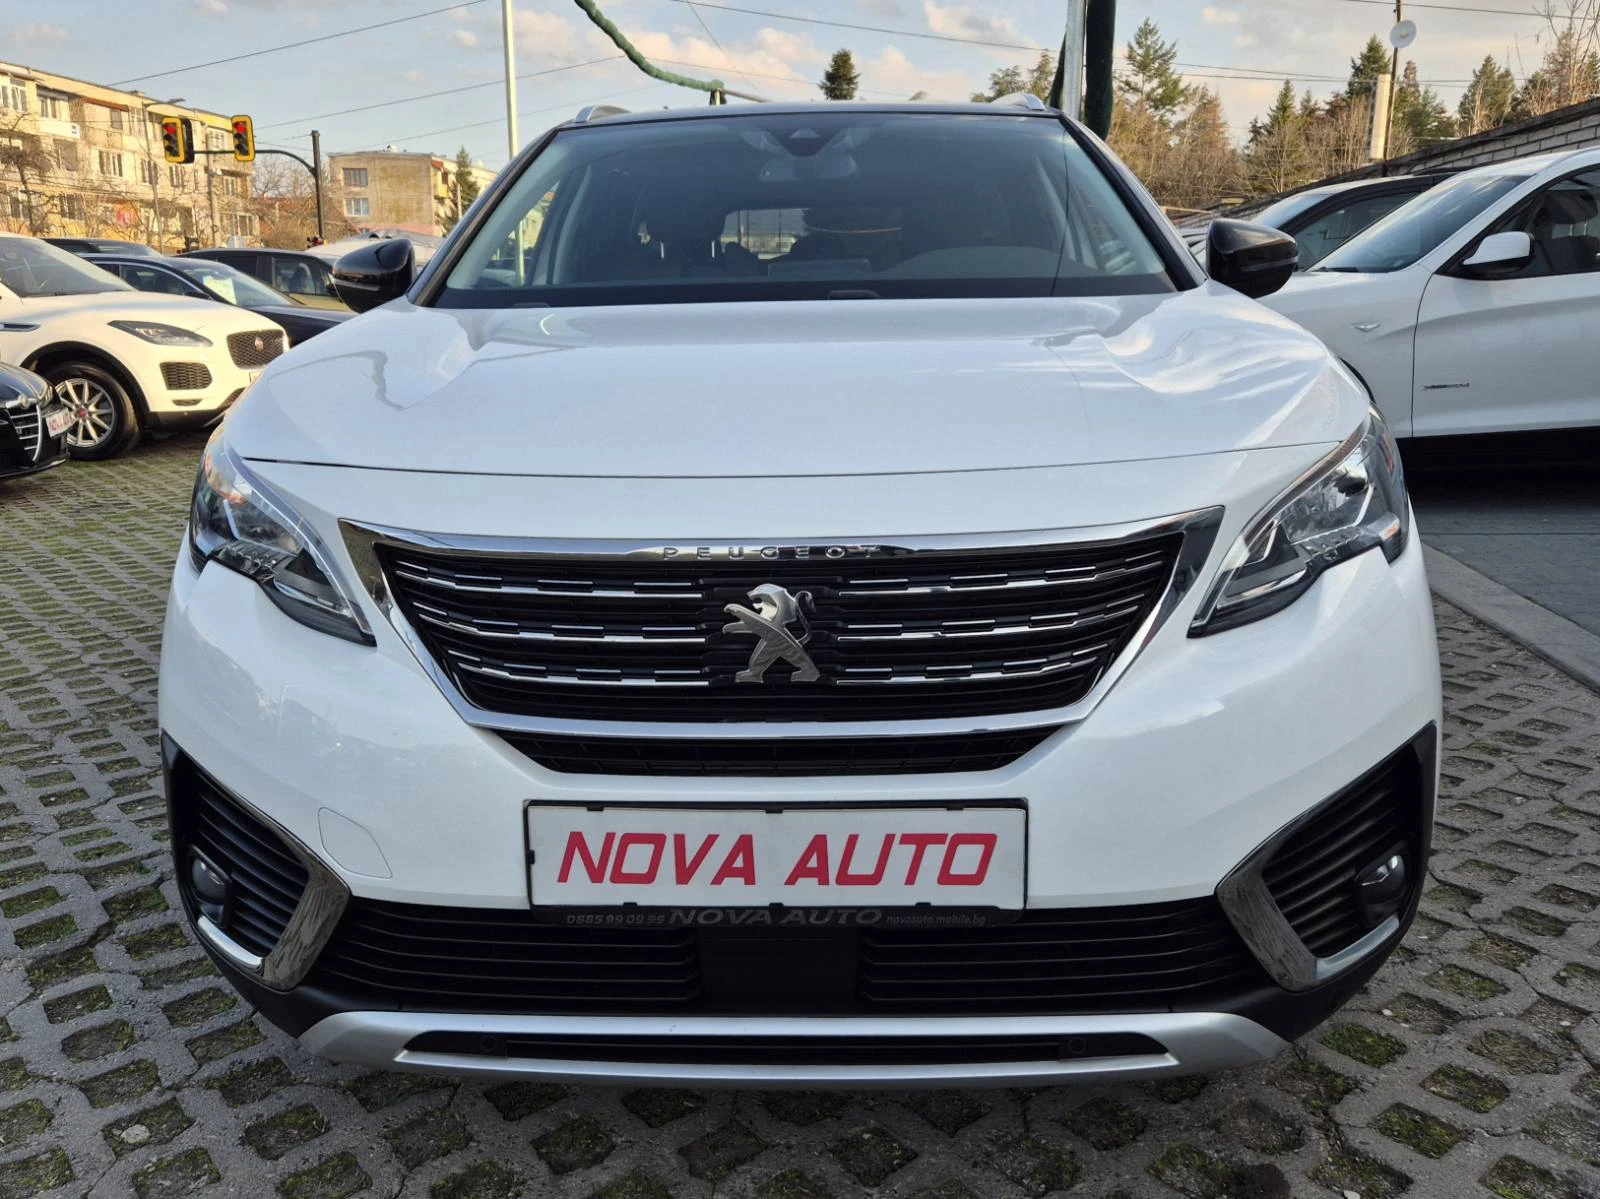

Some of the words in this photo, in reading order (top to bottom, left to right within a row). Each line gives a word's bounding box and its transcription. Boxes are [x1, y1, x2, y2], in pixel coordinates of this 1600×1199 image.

[662, 544, 882, 561] PEUGEOT
[556, 831, 757, 886] NOVA
[783, 832, 998, 887] AUTO
[566, 914, 604, 925] 0885
[667, 908, 773, 925] NOVA
[779, 908, 883, 925] AUTO
